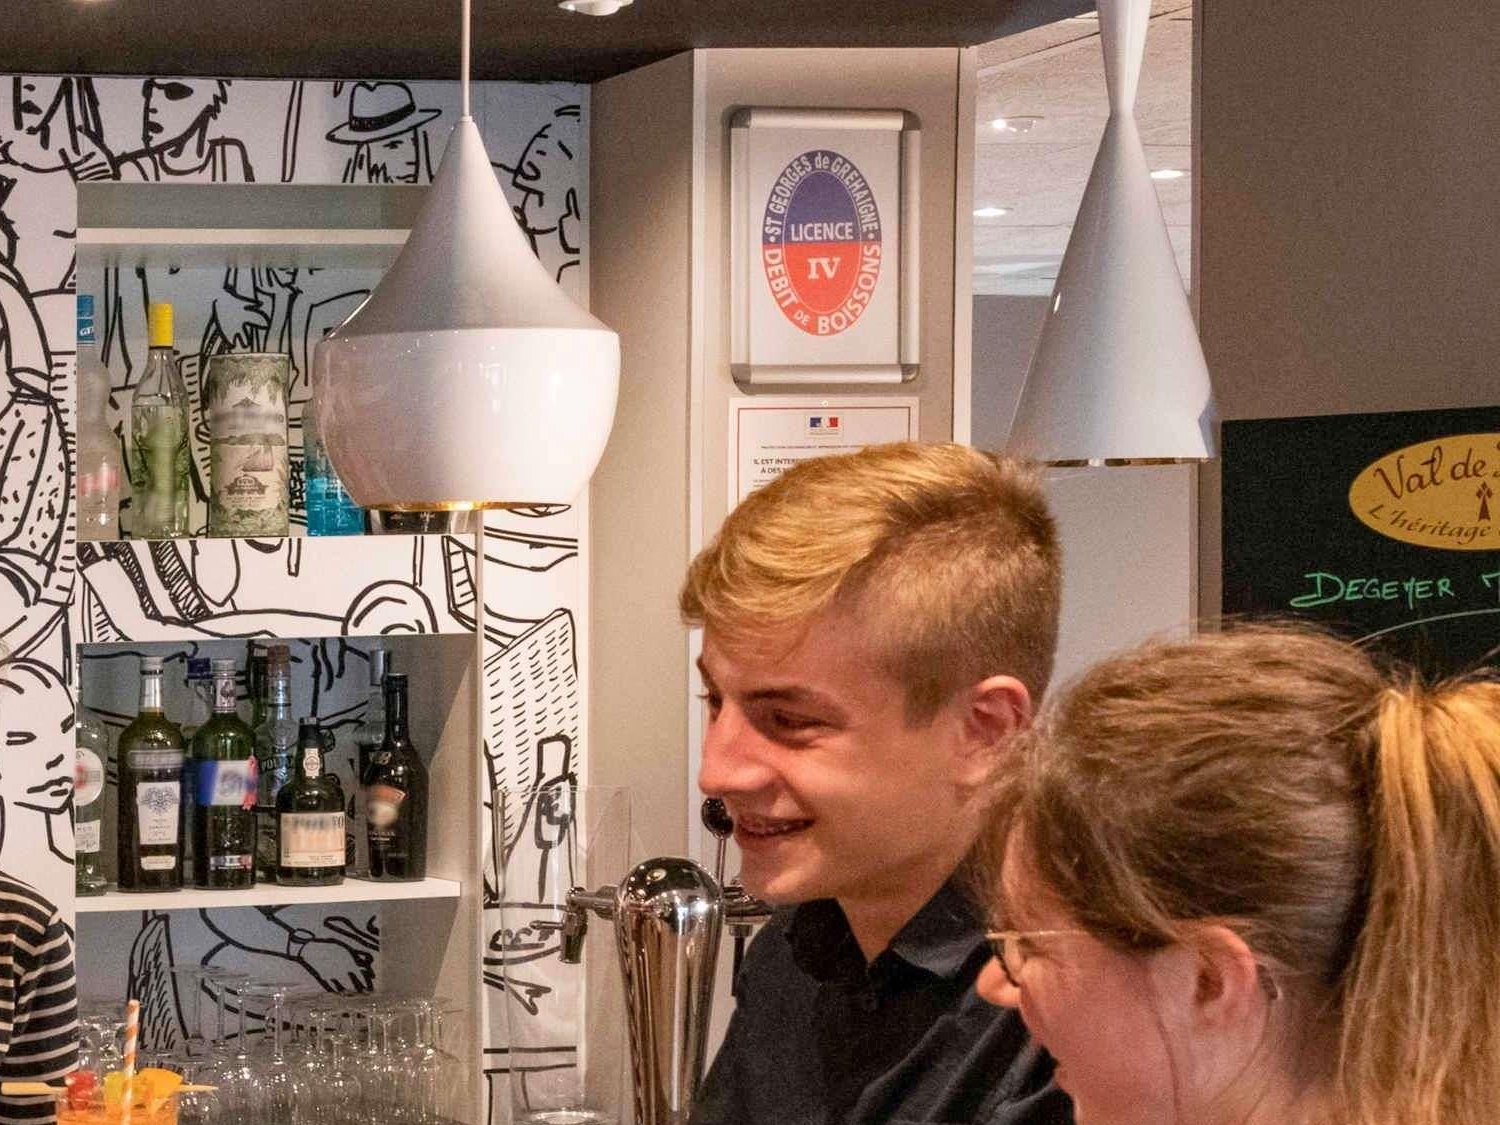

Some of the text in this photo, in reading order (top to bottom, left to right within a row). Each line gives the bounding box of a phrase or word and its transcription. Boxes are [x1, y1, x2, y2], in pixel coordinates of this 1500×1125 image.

[765, 152, 878, 236] ST GEORGES de GREHAIGNE
[791, 222, 854, 241] LICENCE
[765, 244, 881, 334] DEBIT DE BOISSONS
[807, 256, 841, 280] IV
[1373, 445, 1444, 500] Val
[1450, 447, 1487, 481] de
[1368, 504, 1491, 545] L'héritage
